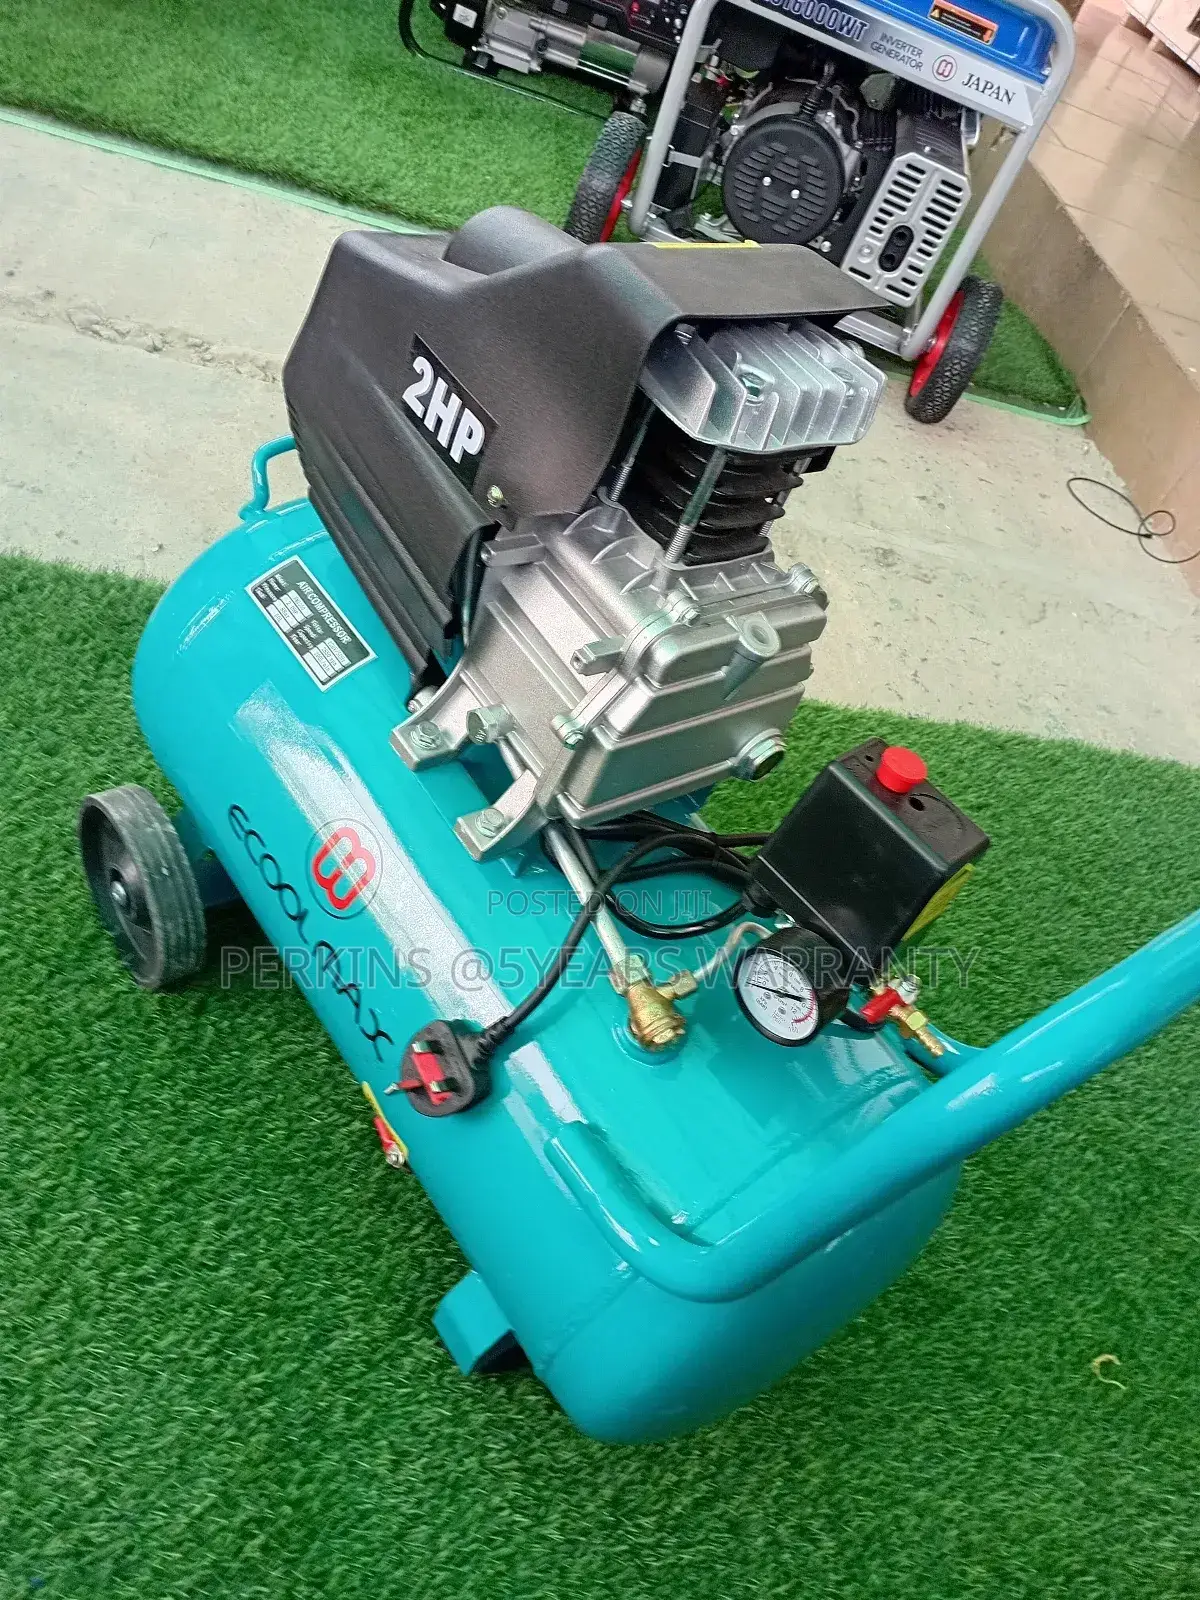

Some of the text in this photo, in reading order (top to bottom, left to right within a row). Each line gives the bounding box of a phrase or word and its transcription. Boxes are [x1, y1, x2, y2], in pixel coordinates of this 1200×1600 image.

[870, 41, 924, 72] GENERATOR
[880, 32, 923, 59] INVERTER
[961, 72, 1016, 105] JAPAN
[402, 356, 485, 464] 2HP
[296, 581, 313, 598] AIR
[308, 592, 352, 645] COMPRESSOR
